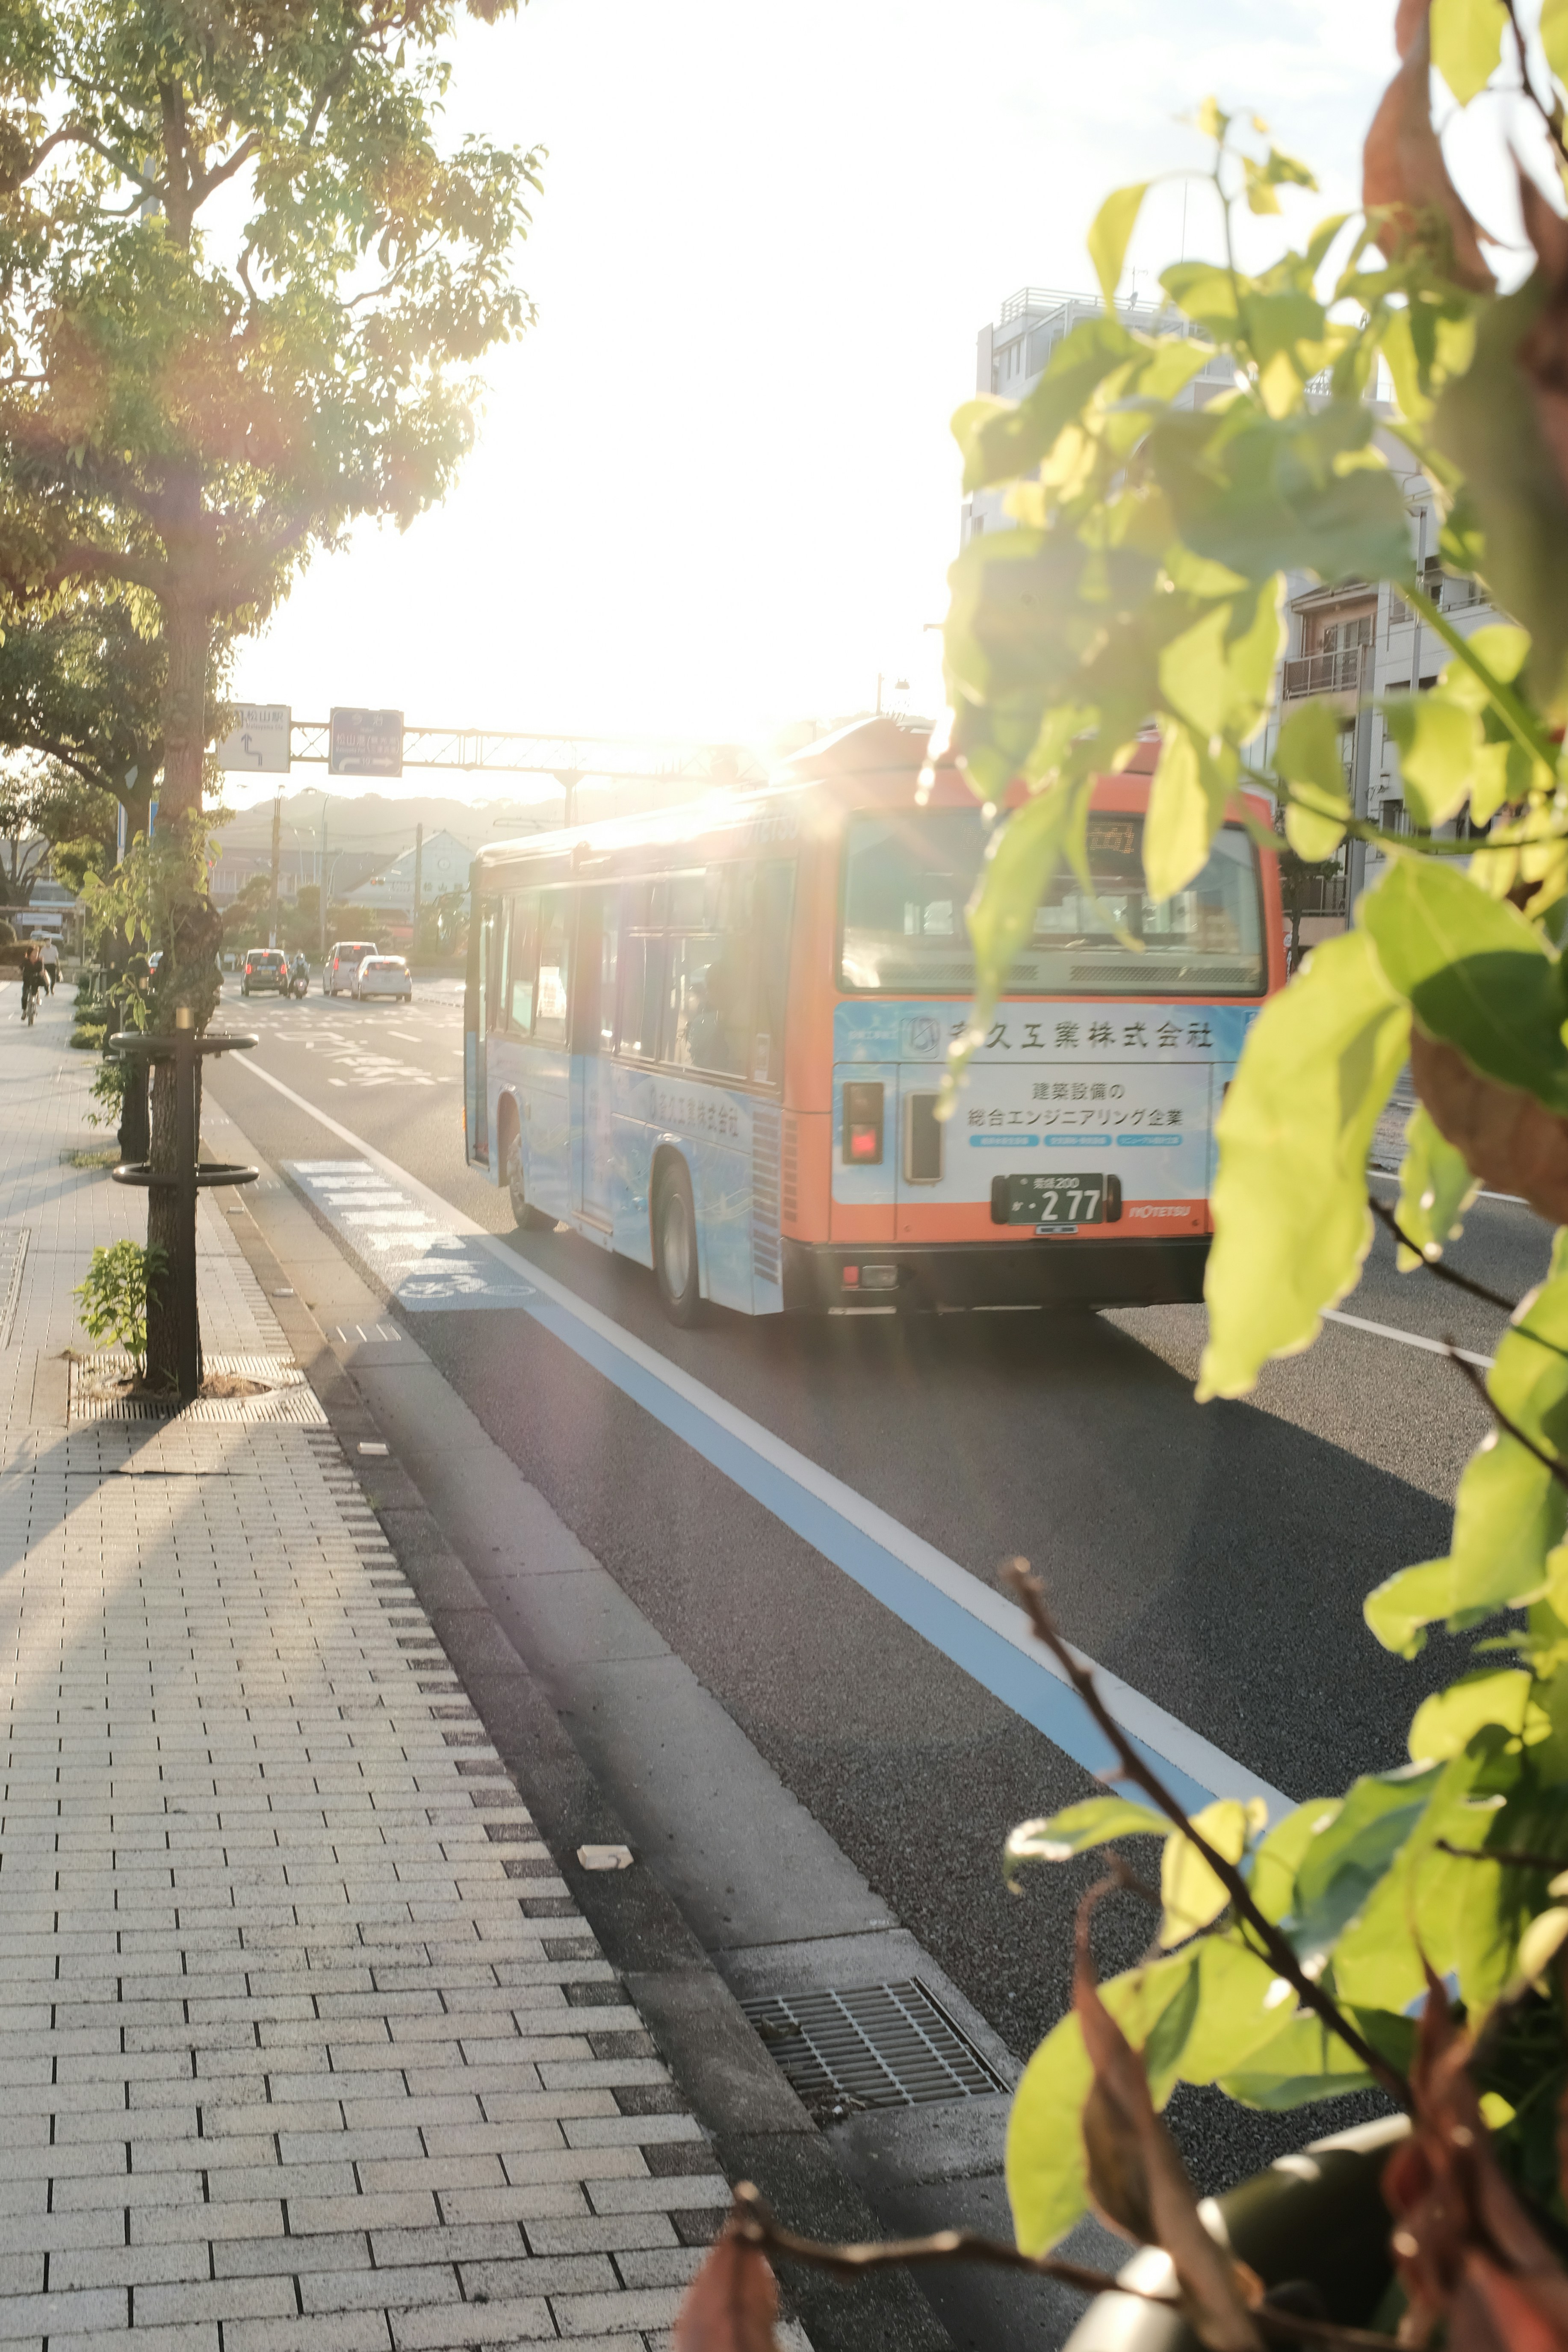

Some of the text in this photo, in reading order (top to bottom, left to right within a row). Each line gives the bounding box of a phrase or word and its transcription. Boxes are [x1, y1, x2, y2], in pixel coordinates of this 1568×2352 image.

[1031, 1081, 1125, 1101] 建築設備の
[967, 1108, 1184, 1127] 総合エンジニアリング企業
